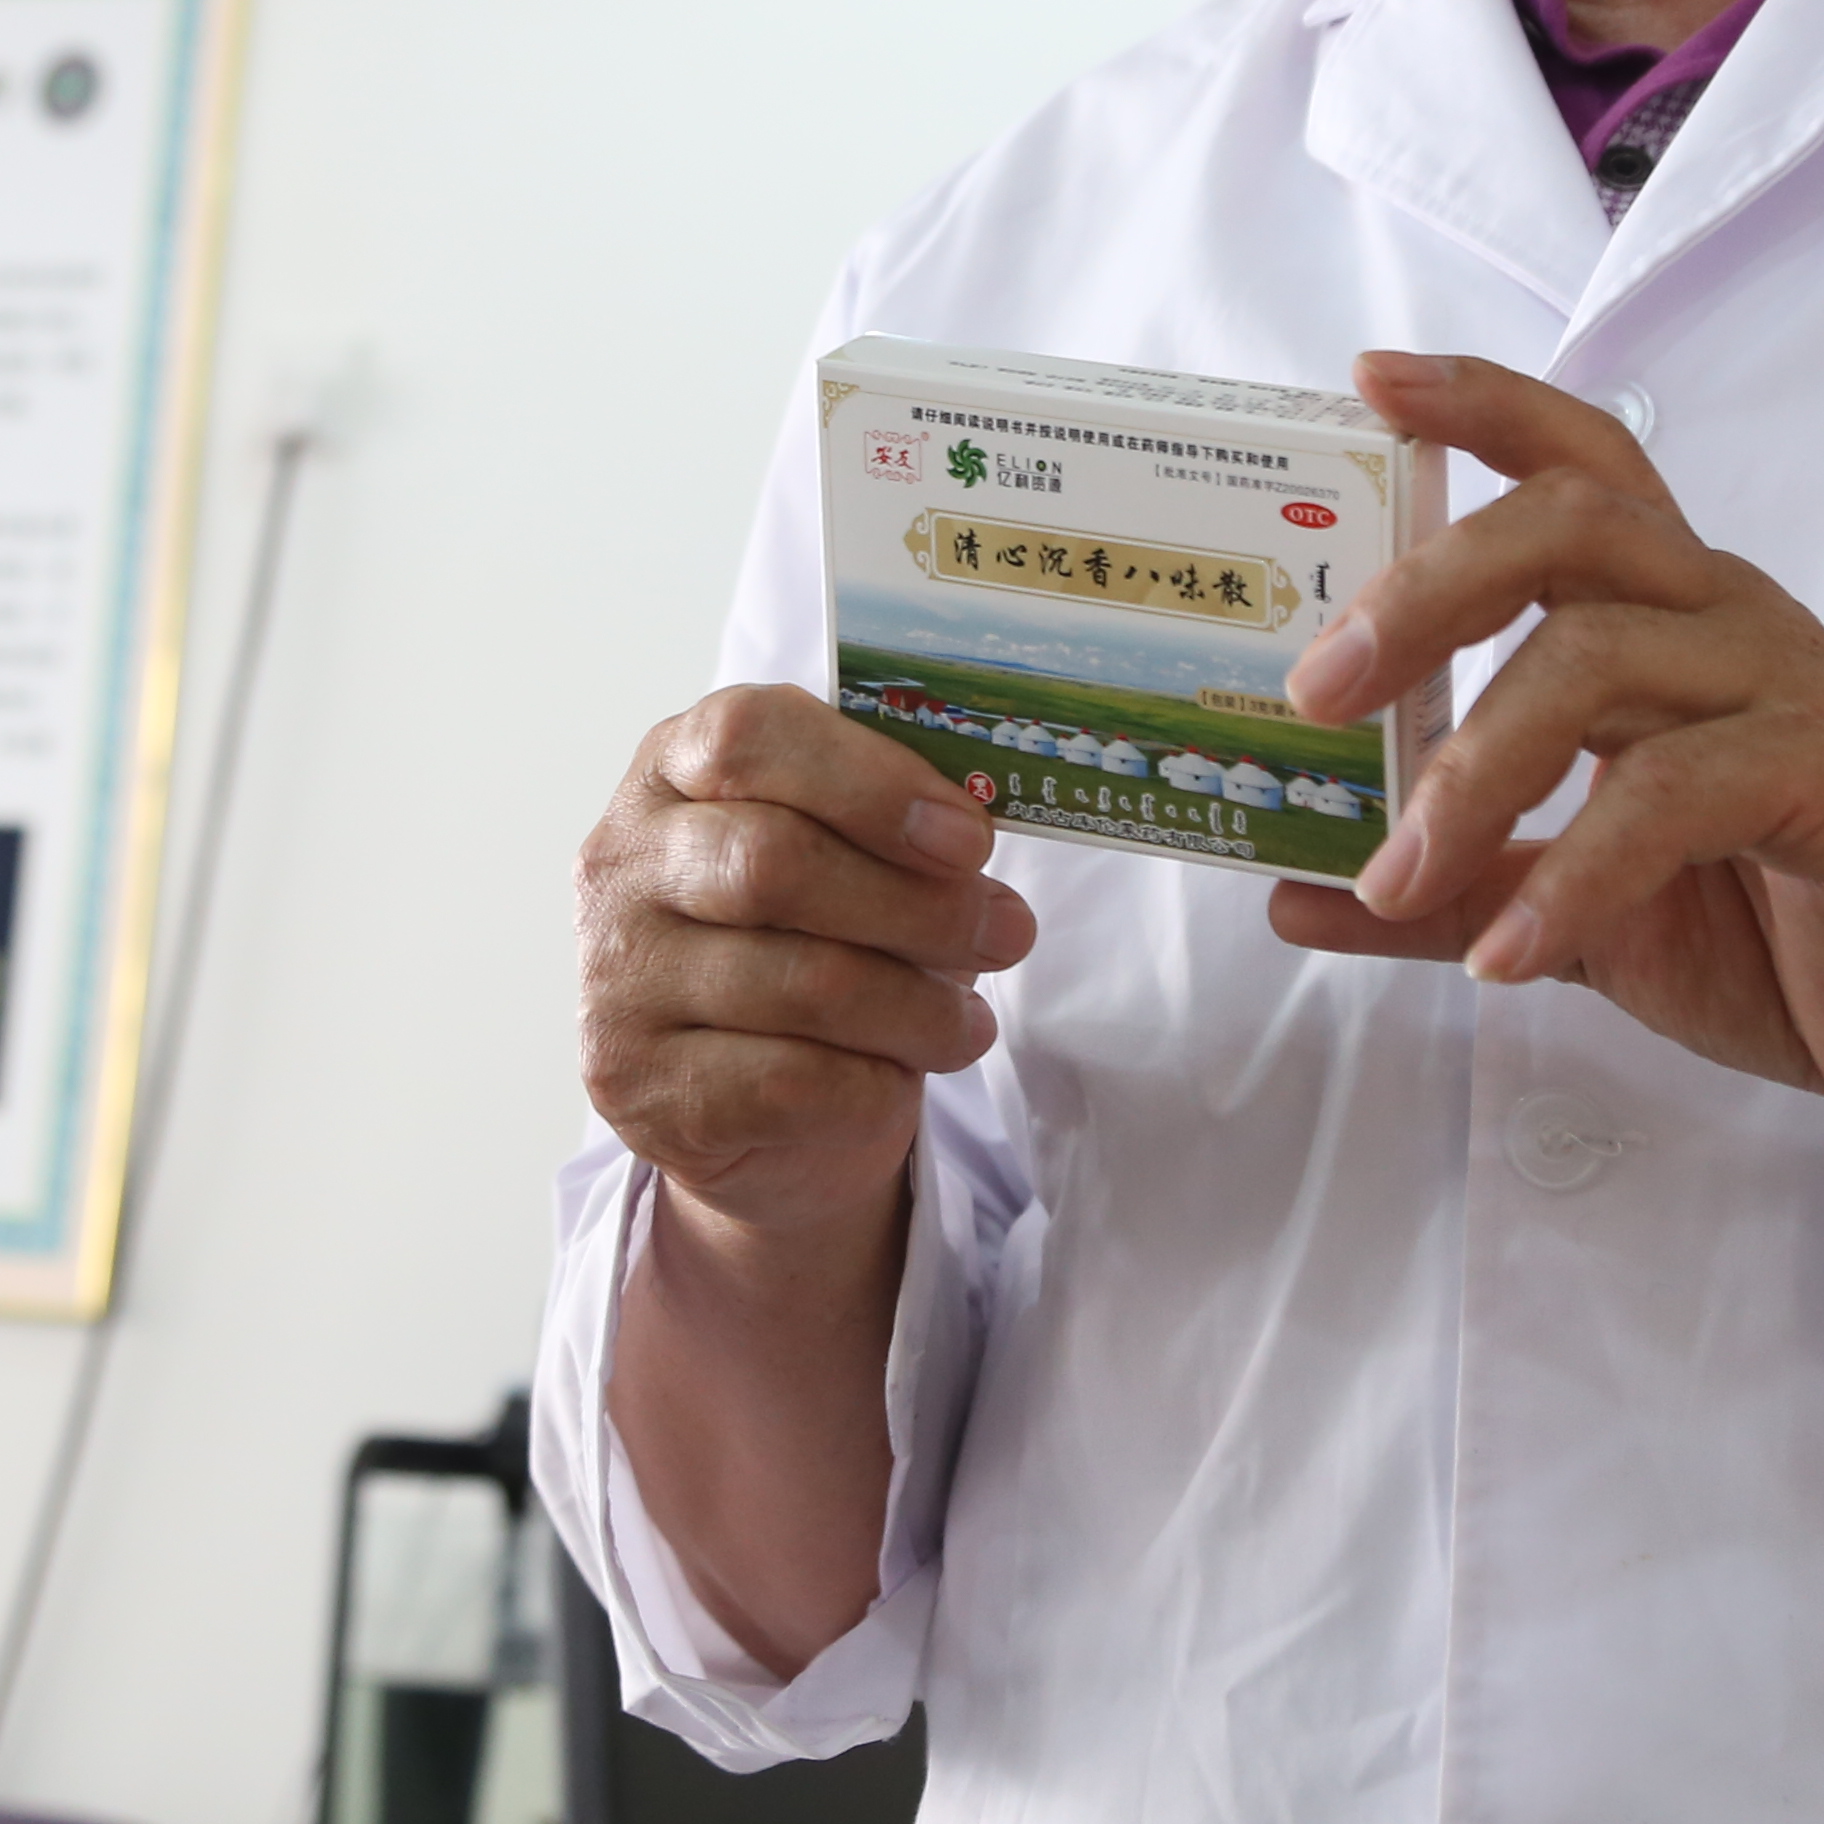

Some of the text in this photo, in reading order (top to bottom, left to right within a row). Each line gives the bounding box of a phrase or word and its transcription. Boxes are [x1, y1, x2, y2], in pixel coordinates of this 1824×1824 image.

[911, 406, 1289, 471] 请仔细阅读说明书并按说明使用或在药师指导下购买和使用
[996, 453, 1062, 474] ELION
[1288, 506, 1331, 526] OTC
[953, 528, 1253, 608] 清心沉香八味散
[1006, 800, 1256, 859] 内蒙古库伦蒙药有限公司
